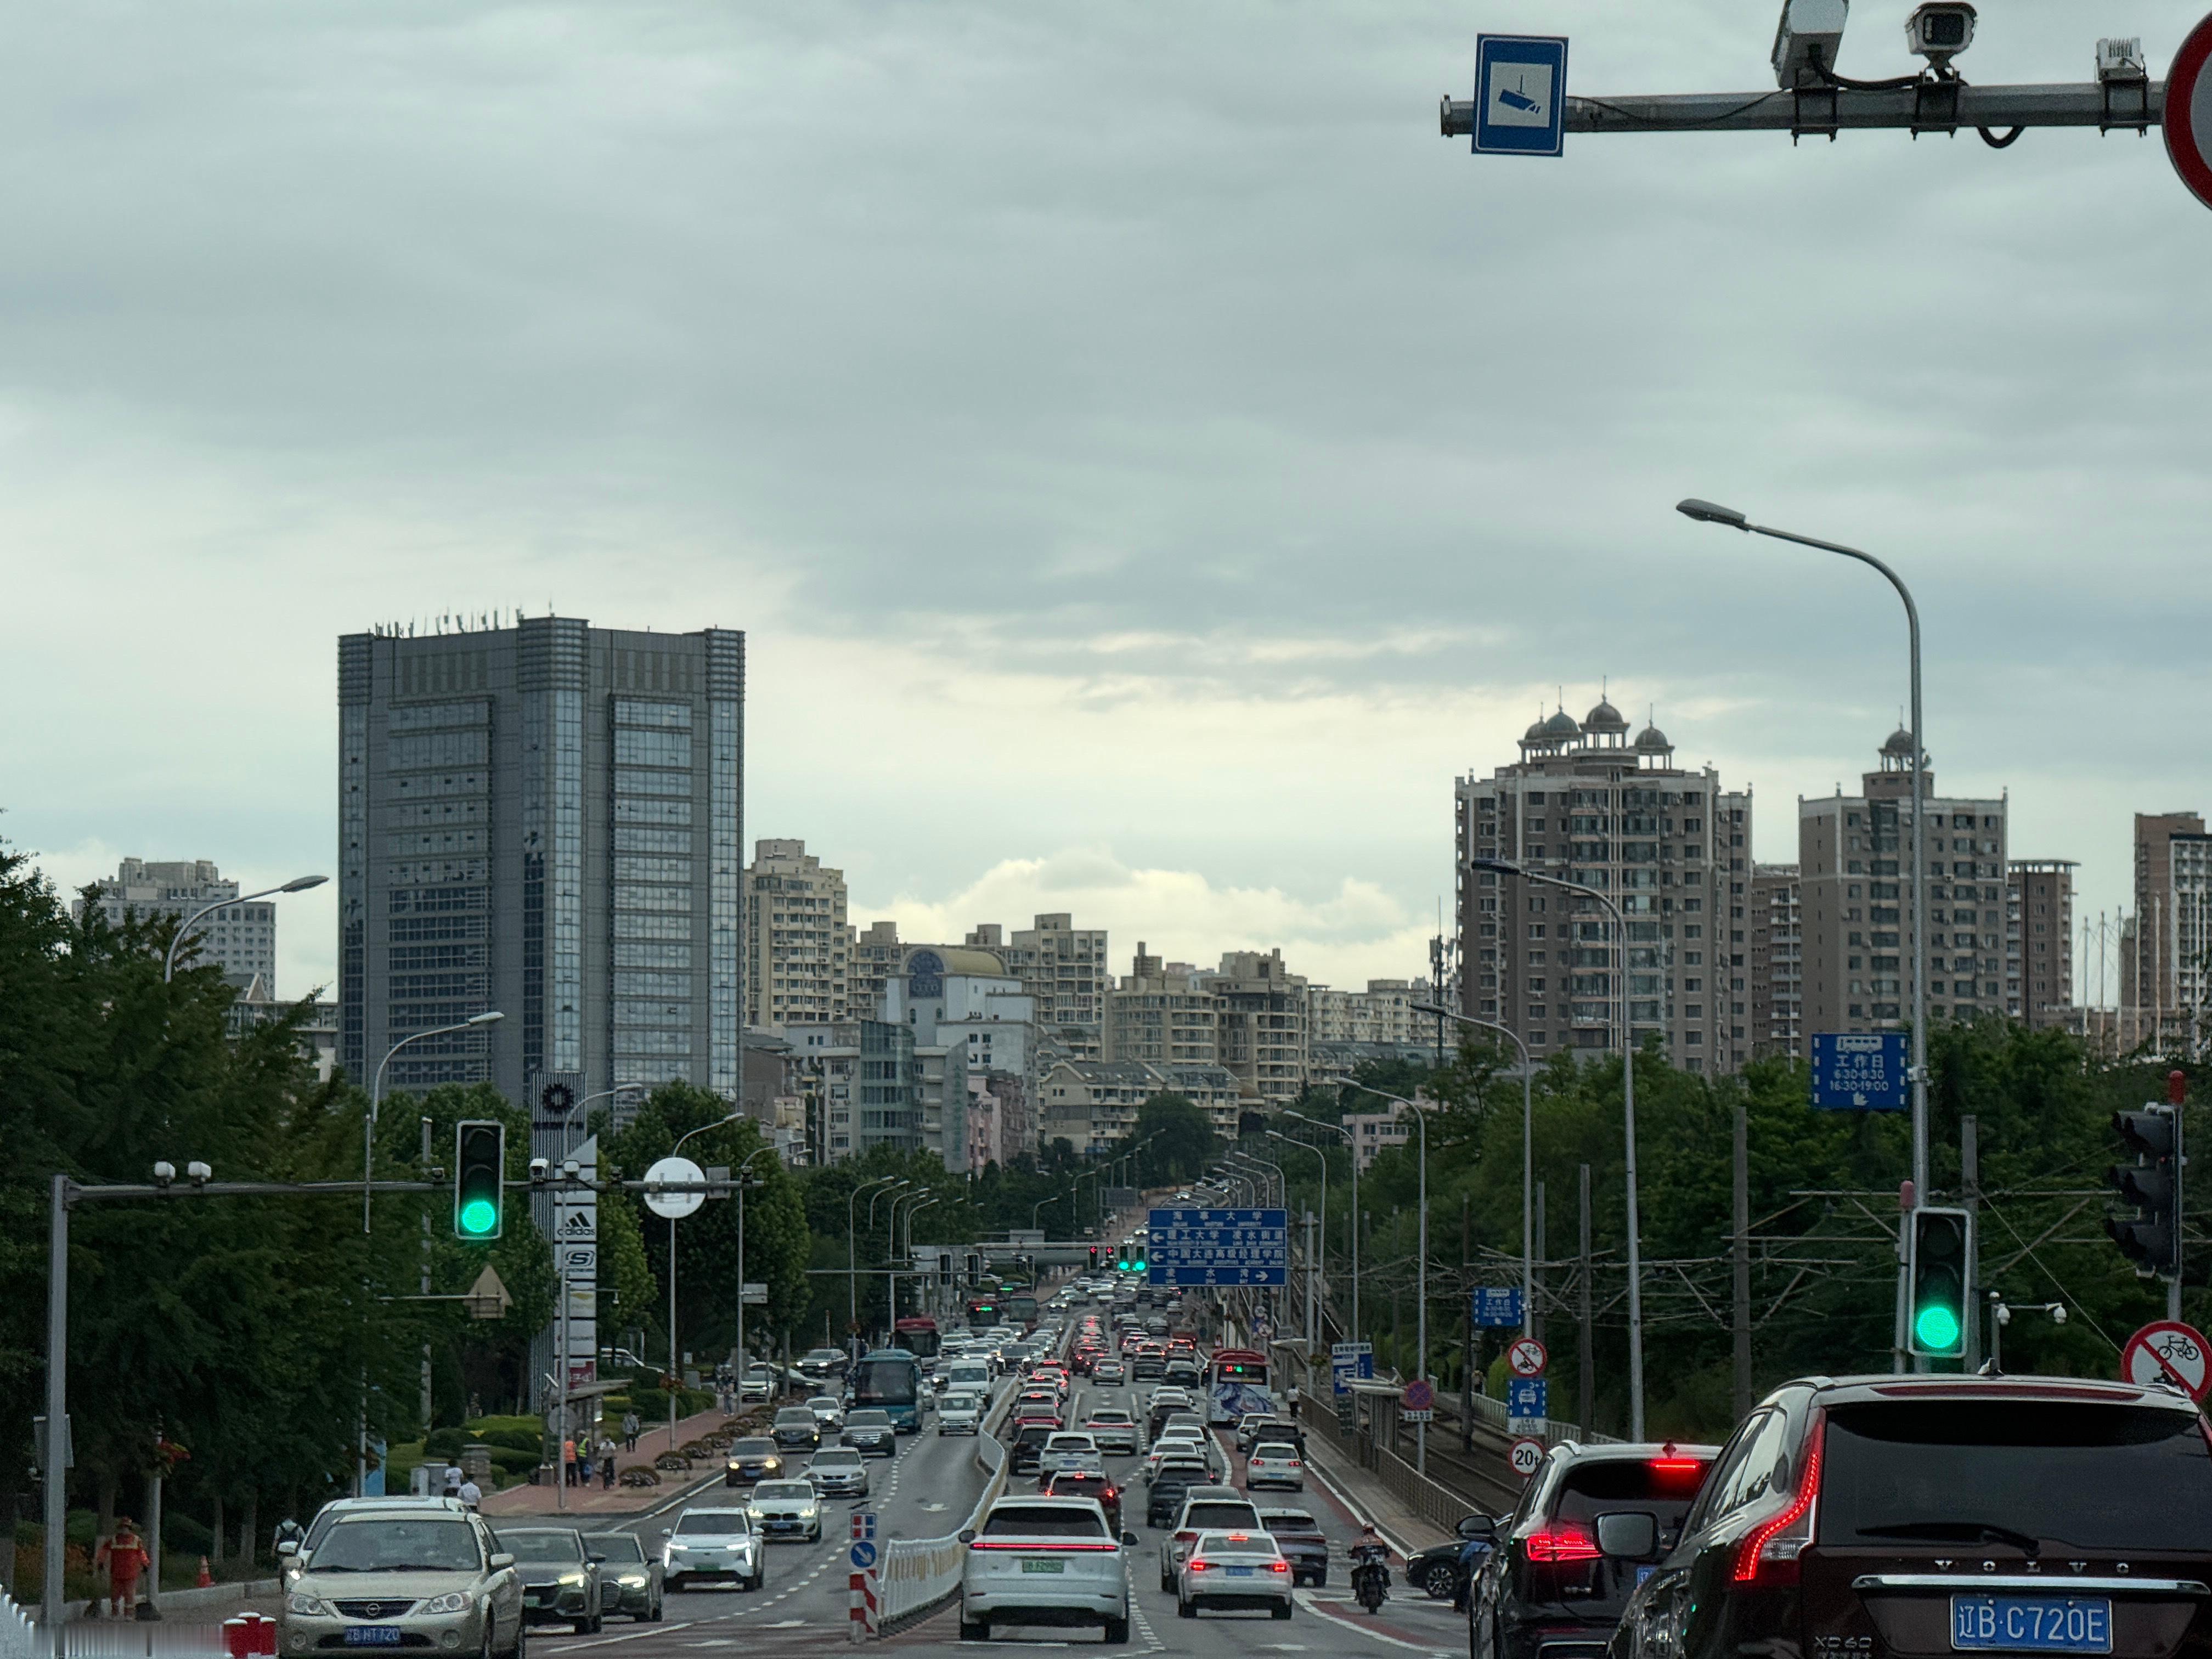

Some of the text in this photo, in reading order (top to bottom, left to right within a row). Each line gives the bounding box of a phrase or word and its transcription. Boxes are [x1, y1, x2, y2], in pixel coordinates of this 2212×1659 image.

[1835, 1054, 1884, 1069] 工作日
[1934, 1560, 2129, 1574] VOLVO
[1959, 1606, 2105, 1642] 辽B·C720E
